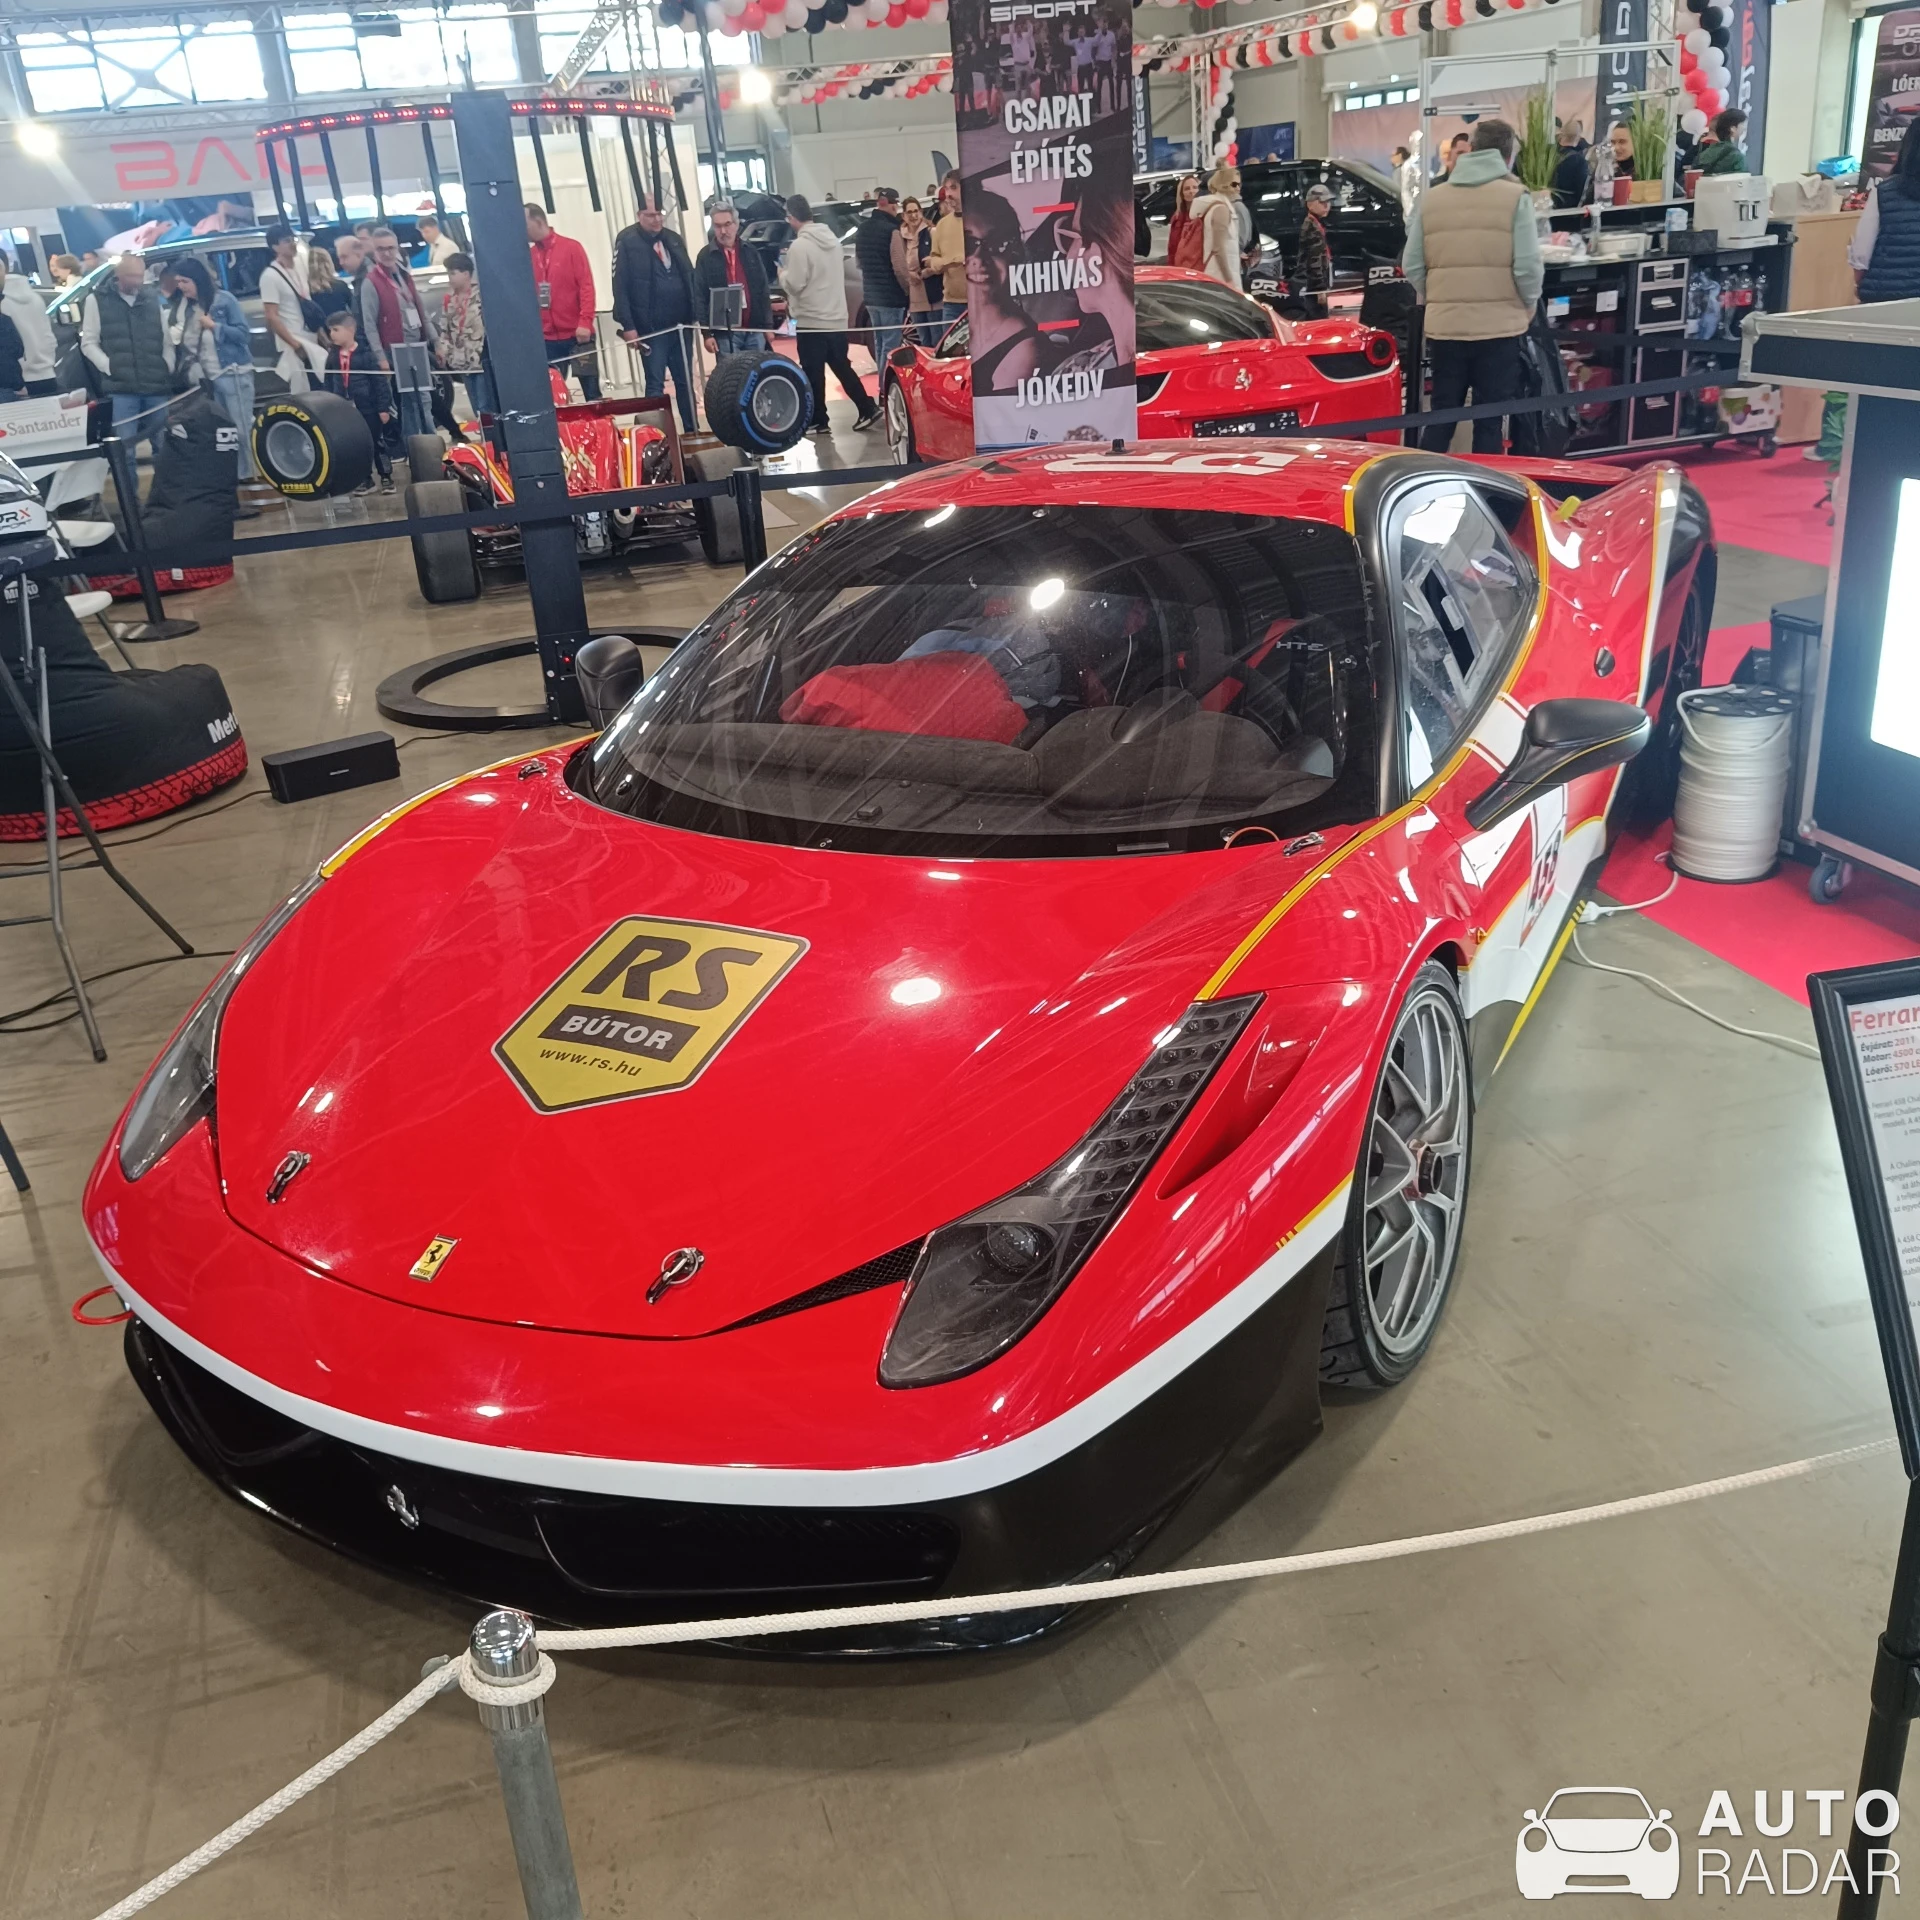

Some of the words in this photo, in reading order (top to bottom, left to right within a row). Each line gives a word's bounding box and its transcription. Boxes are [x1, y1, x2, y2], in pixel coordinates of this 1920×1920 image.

[990, 0, 1097, 22] SPORT
[1004, 92, 1094, 134] CSAPAT
[1010, 135, 1093, 184] ÉPÍTÉS
[1008, 247, 1103, 297] KIHÍVÁS
[1016, 368, 1105, 408] JÓKEDV
[6, 413, 82, 437] Santander
[267, 404, 311, 422] ZERO
[580, 934, 763, 1011] RS
[559, 1014, 674, 1051] BÚTOR
[1850, 1006, 1920, 1032] Ferrar
[1893, 1047, 1914, 1058] 4500
[1894, 1035, 1915, 1047] 2011
[539, 1049, 642, 1078] www.rs.hu
